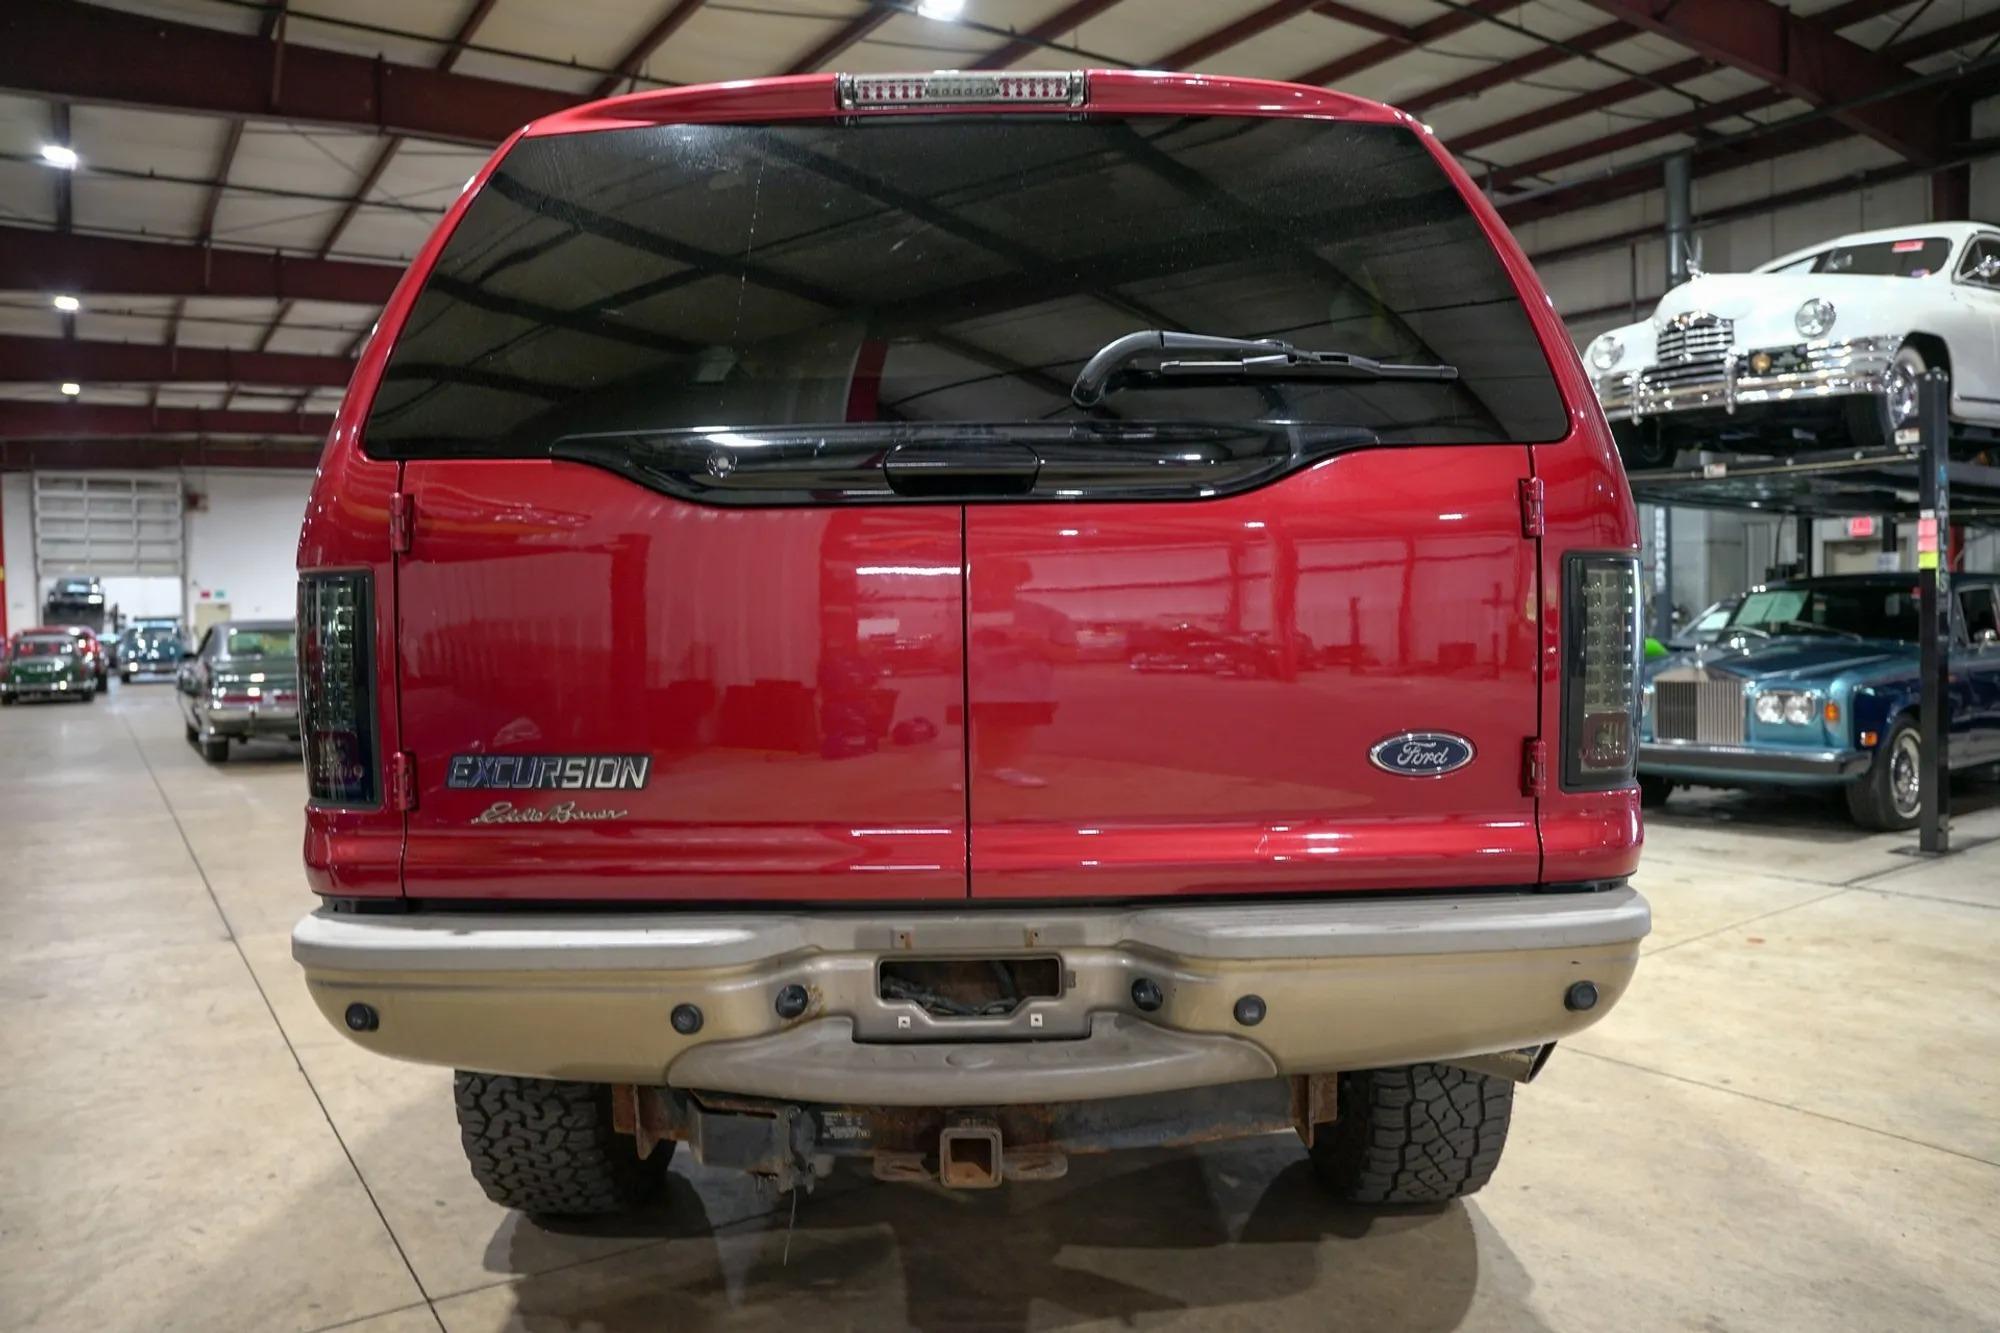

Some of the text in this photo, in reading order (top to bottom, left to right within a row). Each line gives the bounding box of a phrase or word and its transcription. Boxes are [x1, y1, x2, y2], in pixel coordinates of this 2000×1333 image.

[1937, 489, 1949, 593] ATLAS
[1396, 742, 1449, 765] Ford
[448, 756, 649, 789] EXCURSION
[471, 800, 628, 825] Eddie Bauer
